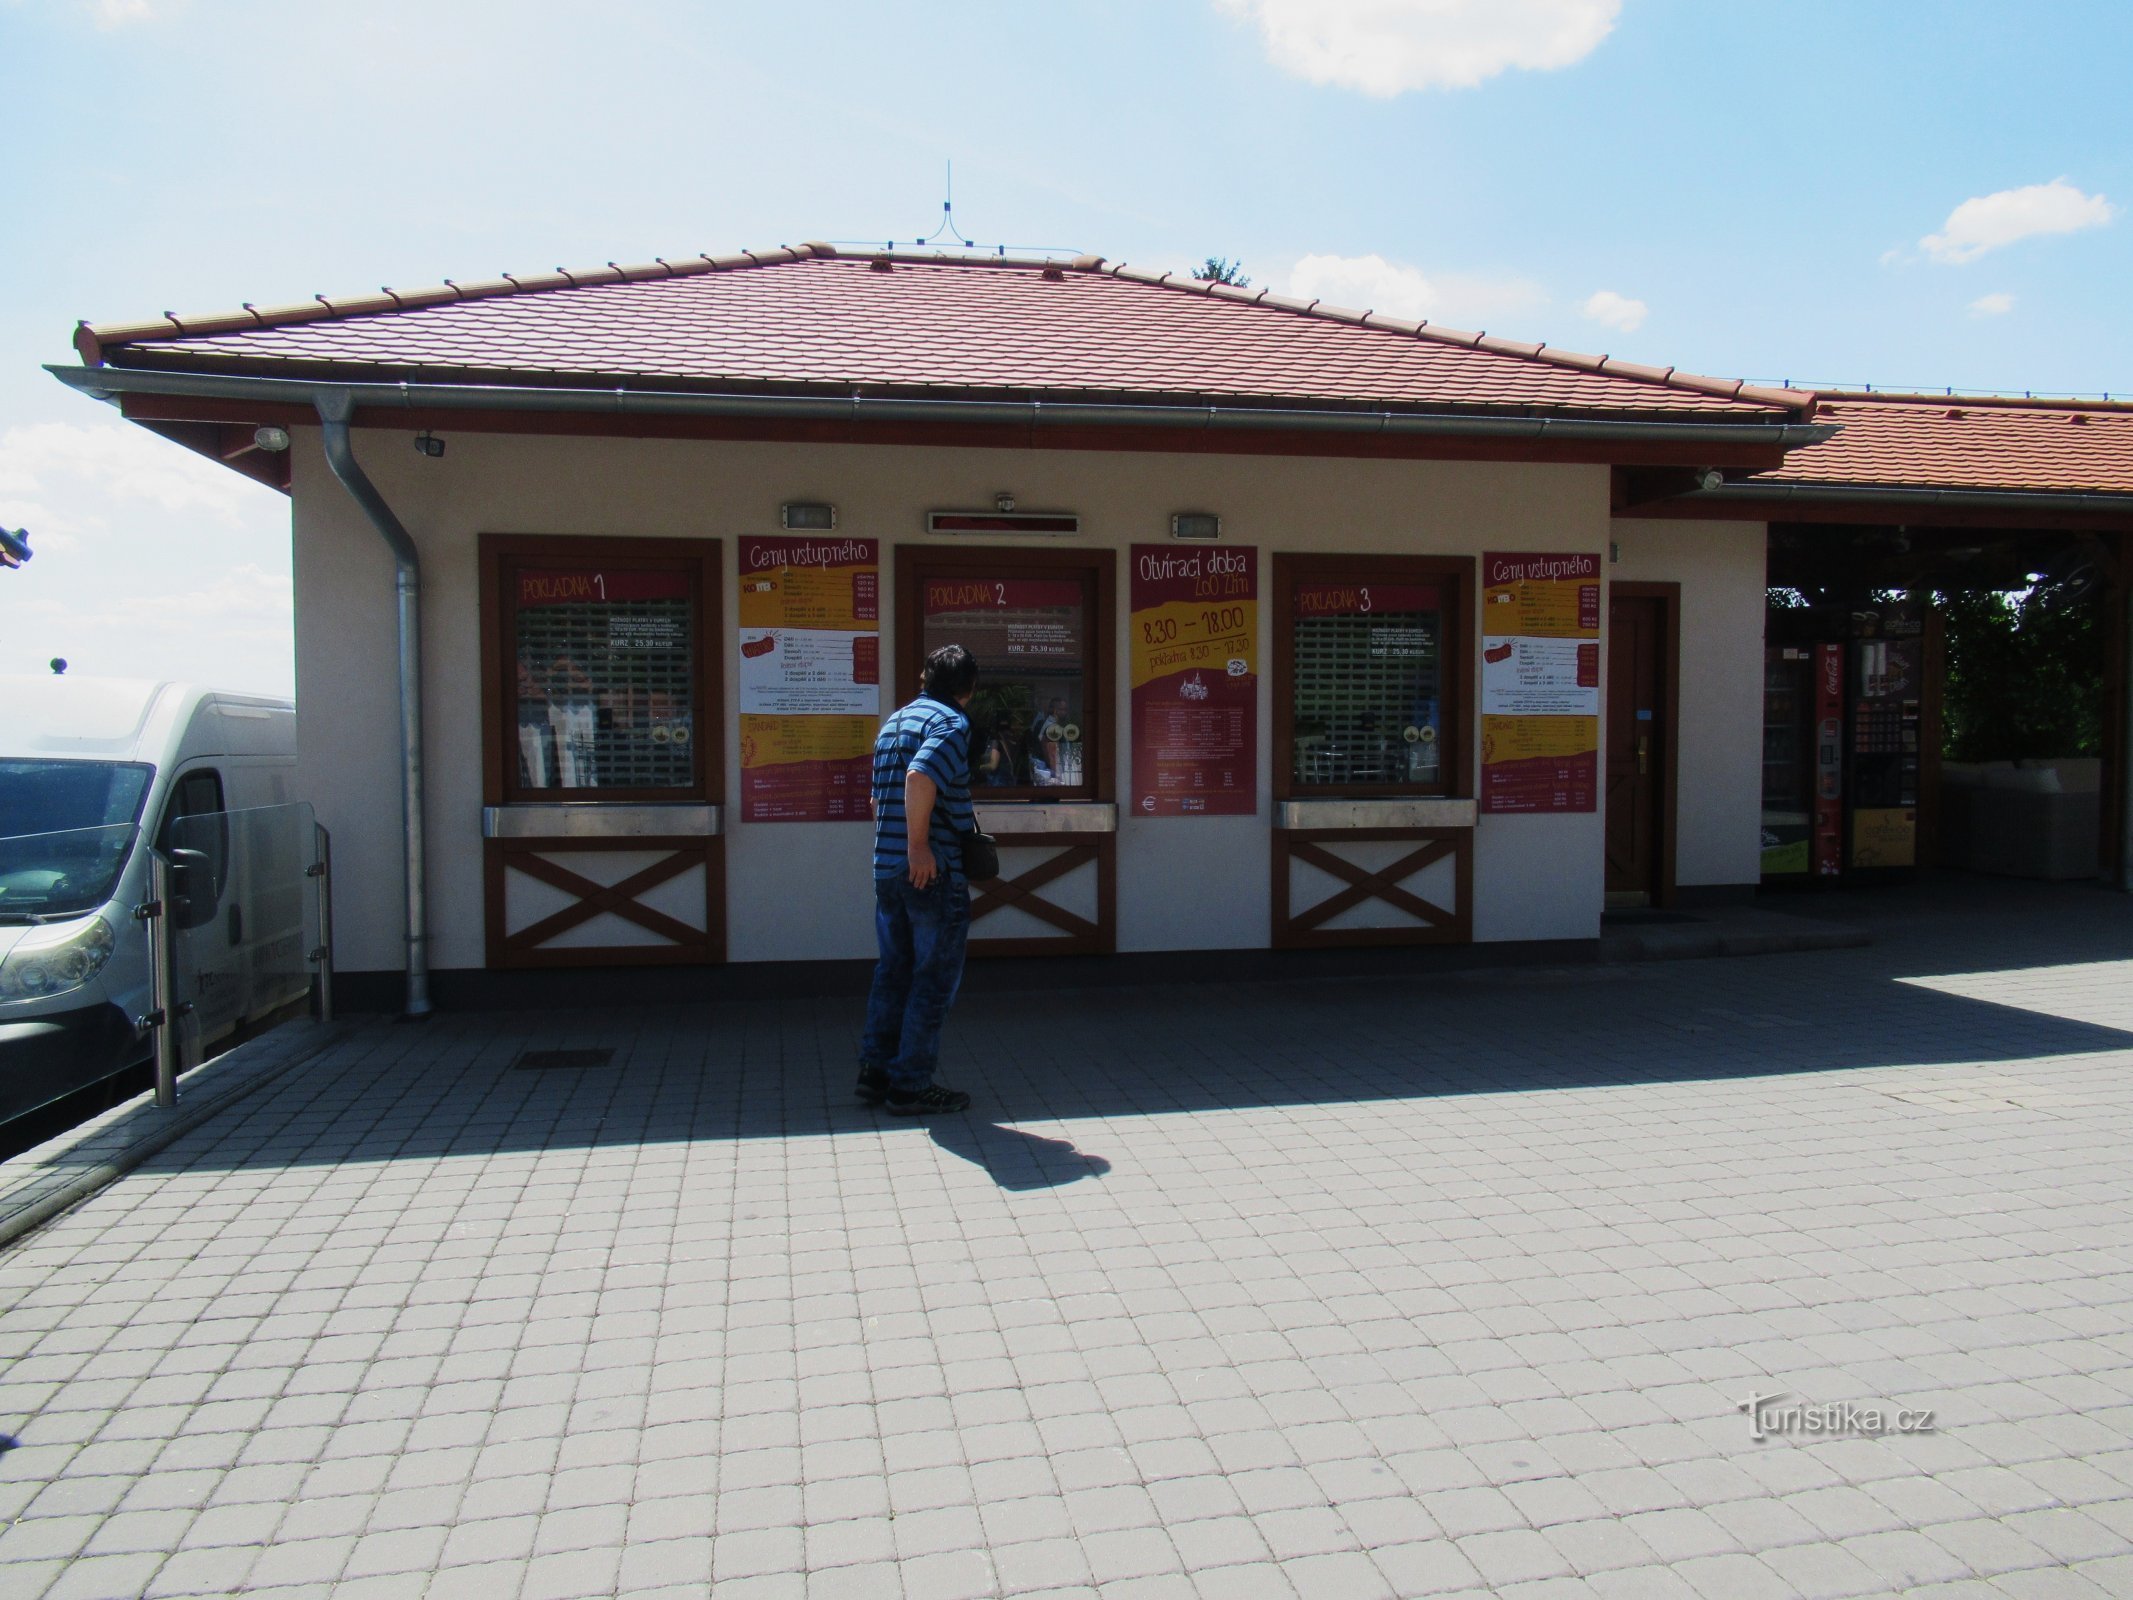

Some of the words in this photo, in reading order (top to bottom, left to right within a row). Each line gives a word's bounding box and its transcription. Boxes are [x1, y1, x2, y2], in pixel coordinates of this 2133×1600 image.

[750, 545, 788, 573] Ceny
[792, 540, 868, 572] vstupného
[1140, 550, 1201, 580] Otvírací
[1207, 550, 1246, 574] doba
[1494, 560, 1524, 586] Ceny
[1528, 554, 1592, 584] vstupného
[523, 576, 592, 600] POKLADNA
[594, 573, 606, 600] 1
[930, 584, 992, 608] POKLADNA
[996, 584, 1006, 606] 2
[1301, 590, 1358, 612] POKLADNA
[1360, 588, 1372, 612] 3
[1144, 618, 1176, 644] 8.30
[1202, 606, 1244, 634] 18.00
[1150, 649, 1187, 673] pokladna
